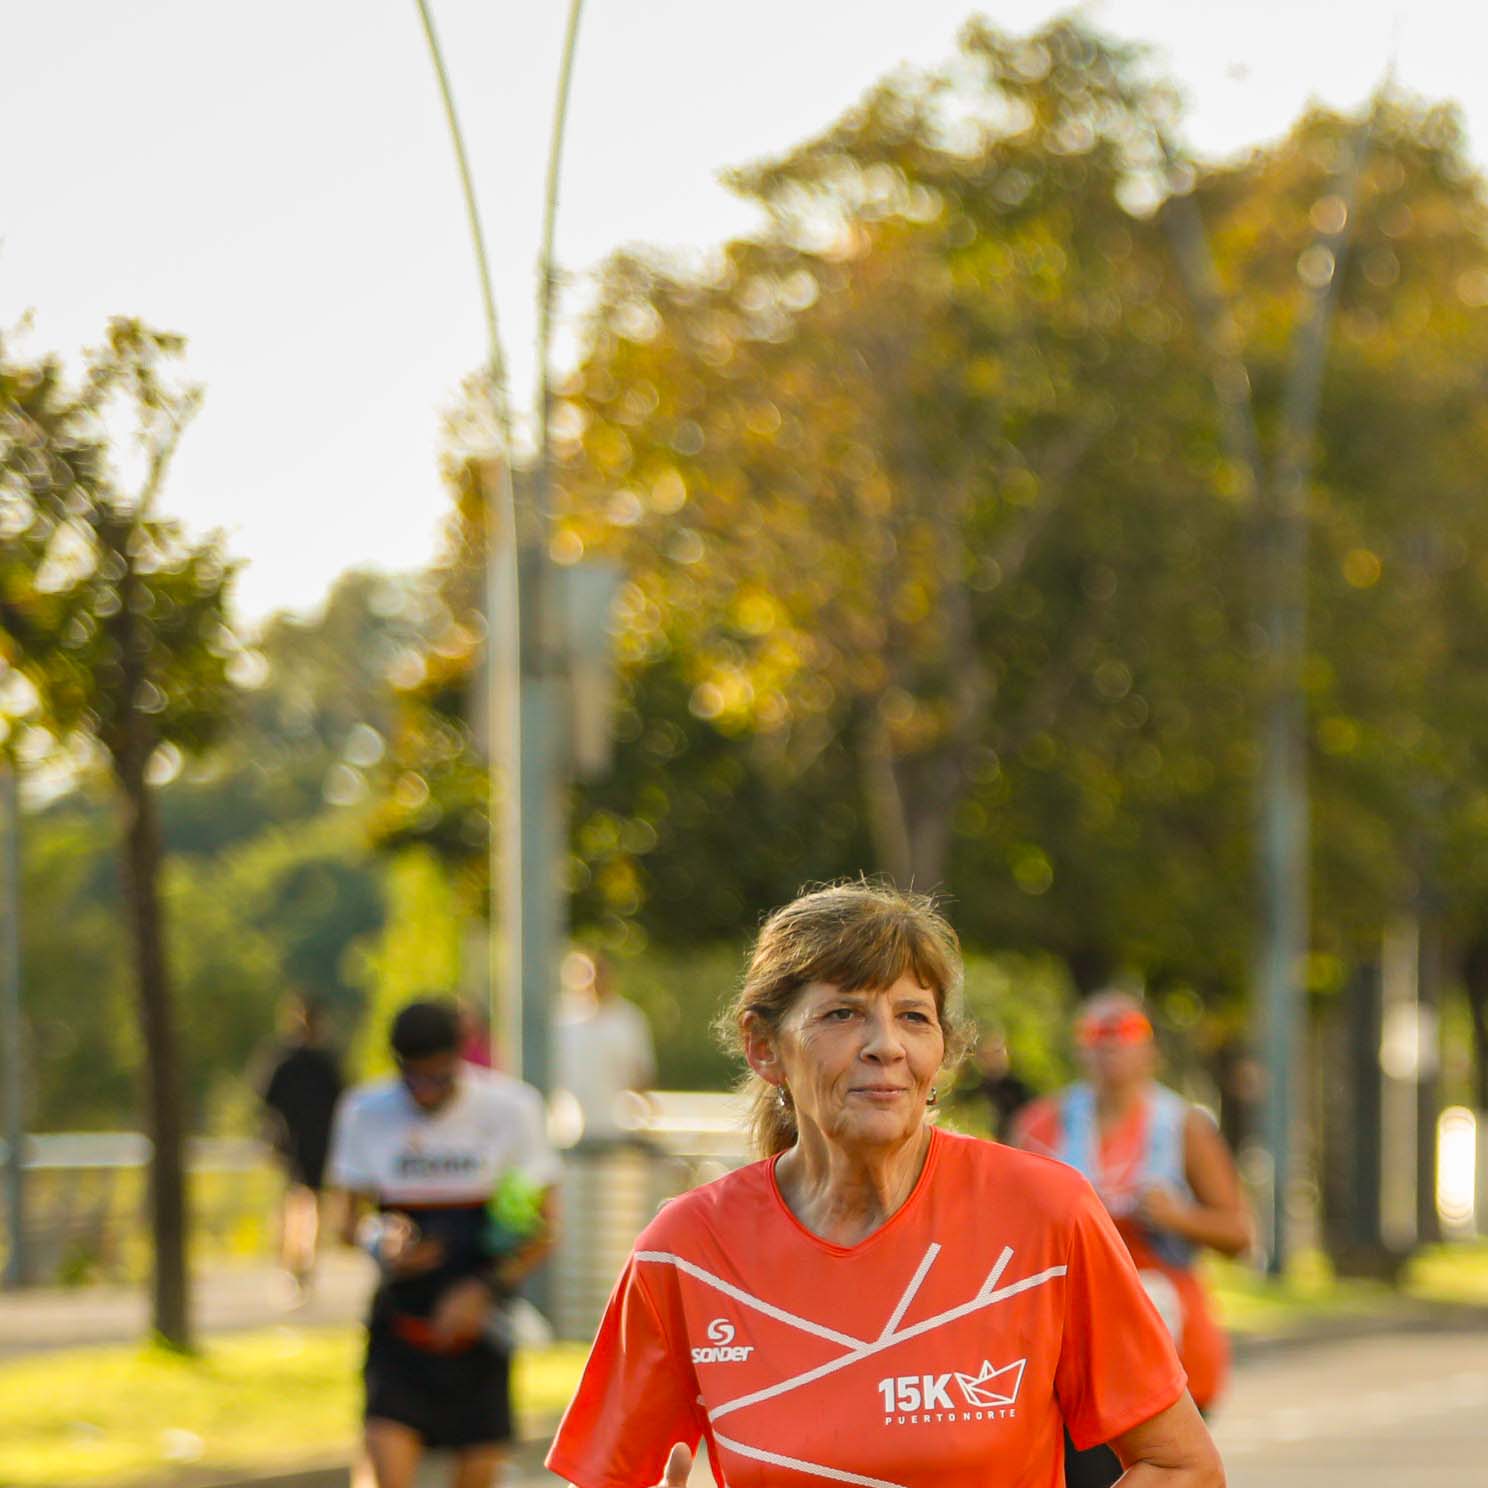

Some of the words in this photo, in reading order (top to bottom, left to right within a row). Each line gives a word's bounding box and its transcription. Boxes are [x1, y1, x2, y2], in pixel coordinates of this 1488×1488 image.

[878, 1373, 954, 1412] 15K
[886, 1413, 956, 1425] PUERTO
[963, 1408, 1016, 1420] NORTE
